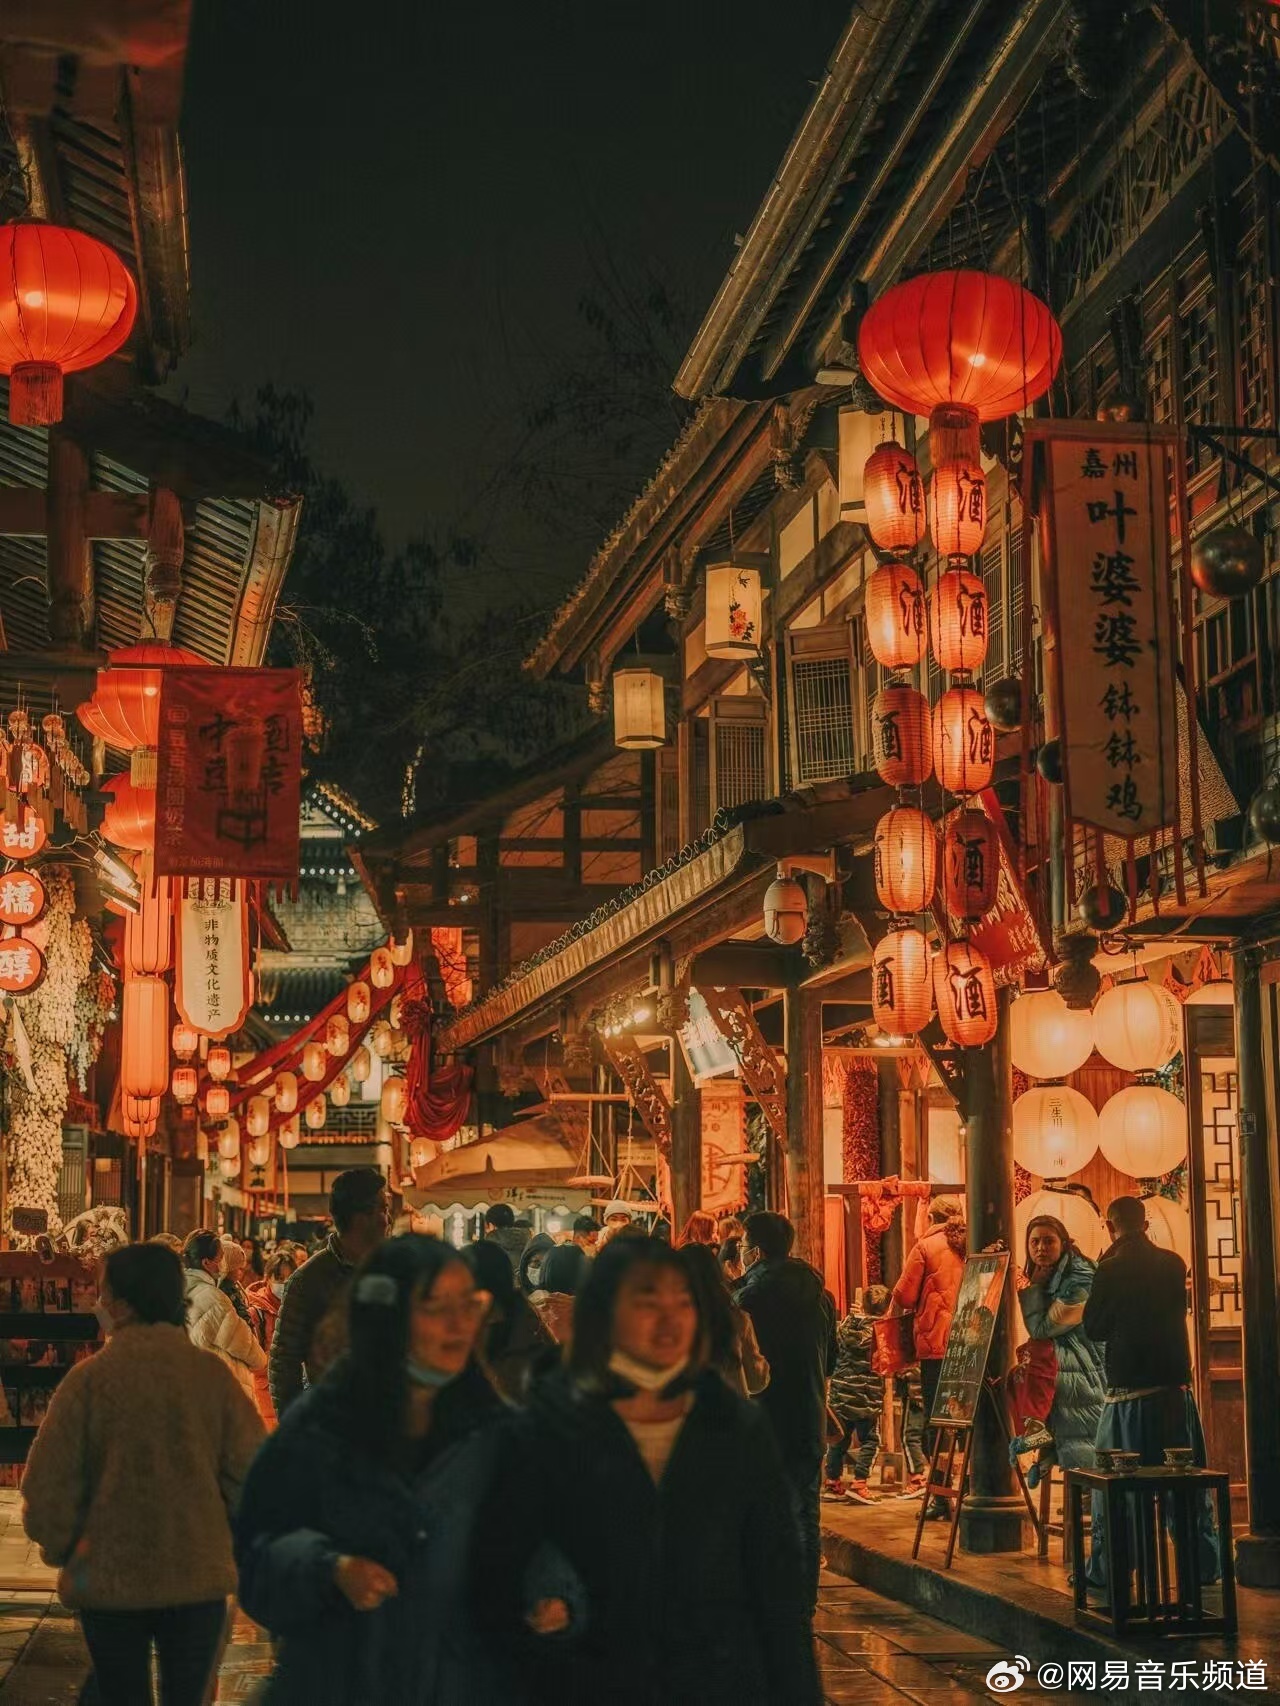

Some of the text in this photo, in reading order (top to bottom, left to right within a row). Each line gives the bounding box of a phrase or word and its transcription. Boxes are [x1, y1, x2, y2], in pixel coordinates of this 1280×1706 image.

[896, 461, 921, 514] 酒
[1080, 448, 1138, 480] 嘉州
[957, 469, 985, 530] 酒
[900, 581, 924, 636] 酒
[957, 583, 986, 642] 酒
[968, 706, 993, 768] 酒
[952, 831, 984, 892] 酒
[204, 918, 221, 1022] 非物质文化遗产
[949, 964, 987, 1021] 酒
